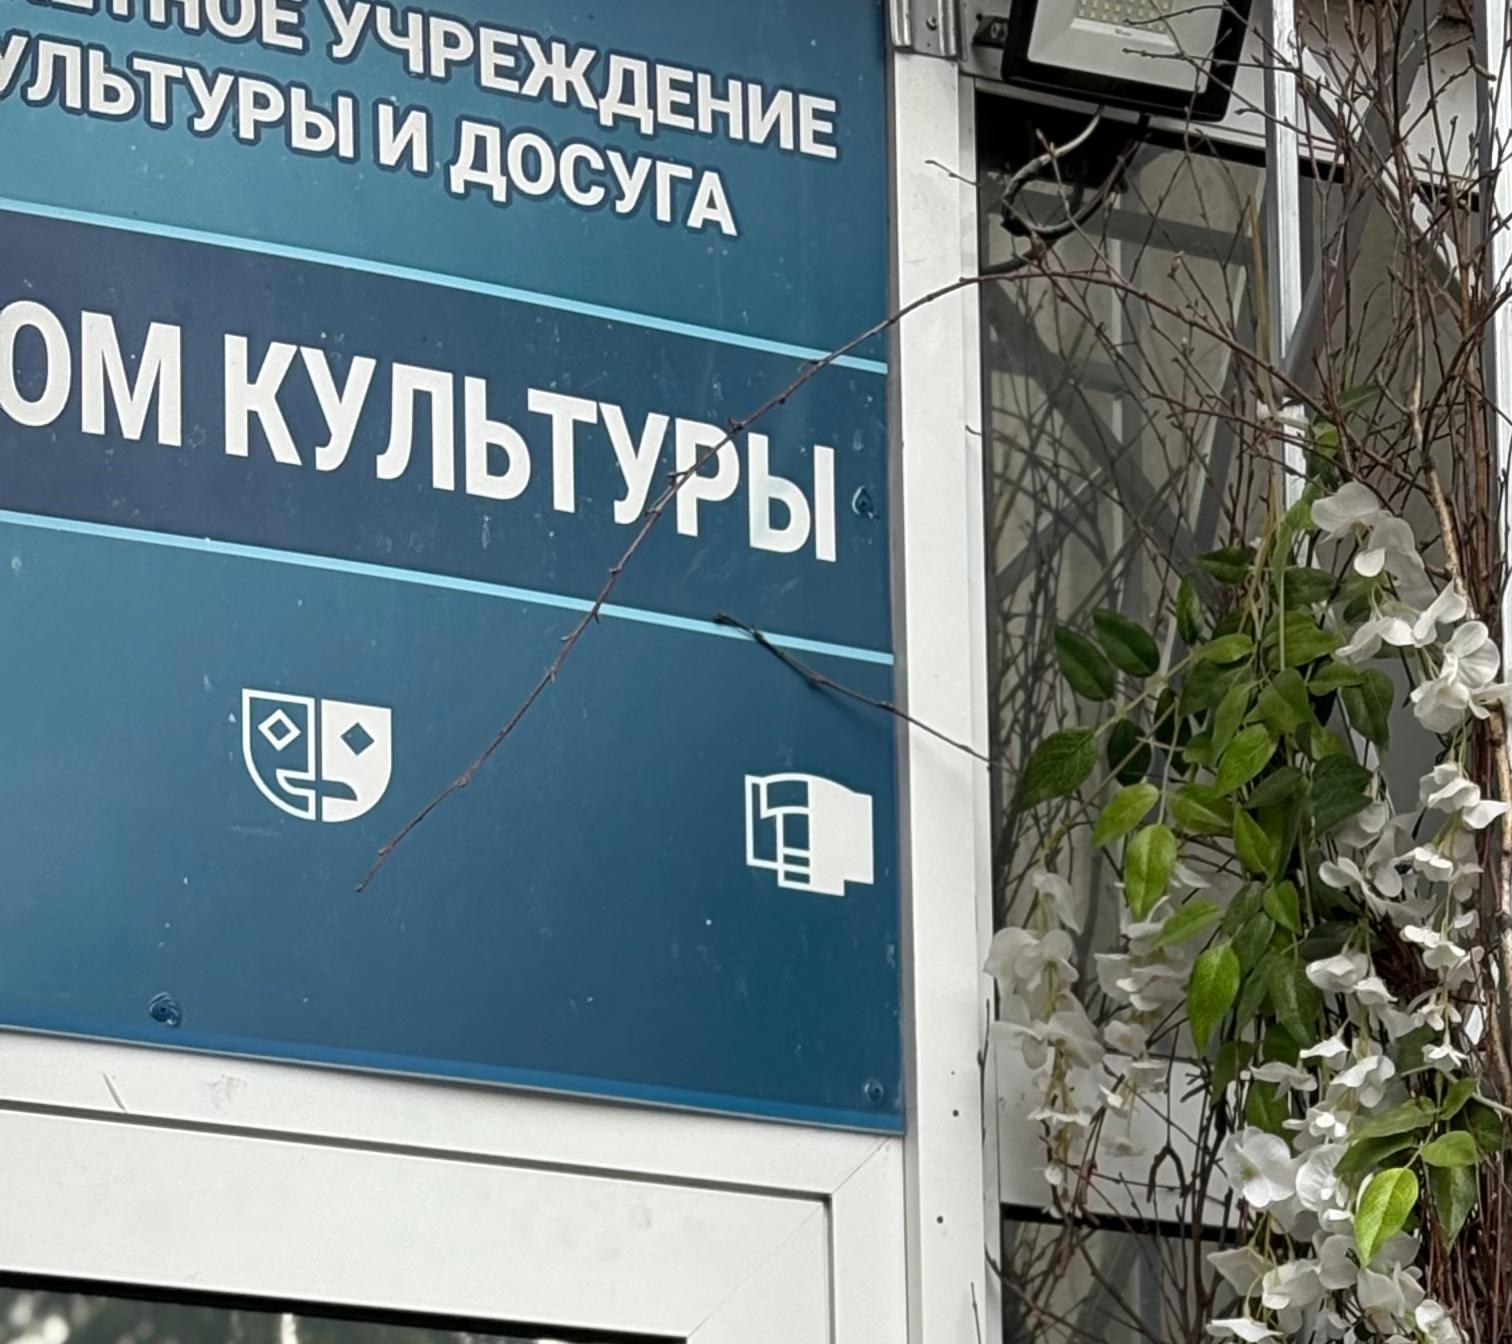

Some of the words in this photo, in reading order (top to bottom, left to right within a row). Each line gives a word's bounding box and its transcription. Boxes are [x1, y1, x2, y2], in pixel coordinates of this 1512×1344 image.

[323, 0, 838, 160] УЧРЕЖДЕНИЕ
[378, 104, 429, 173] И
[449, 120, 739, 237] ДОСУГА
[0, 300, 182, 447] ОМ
[224, 333, 837, 562] КУЛЬТУРЫ
